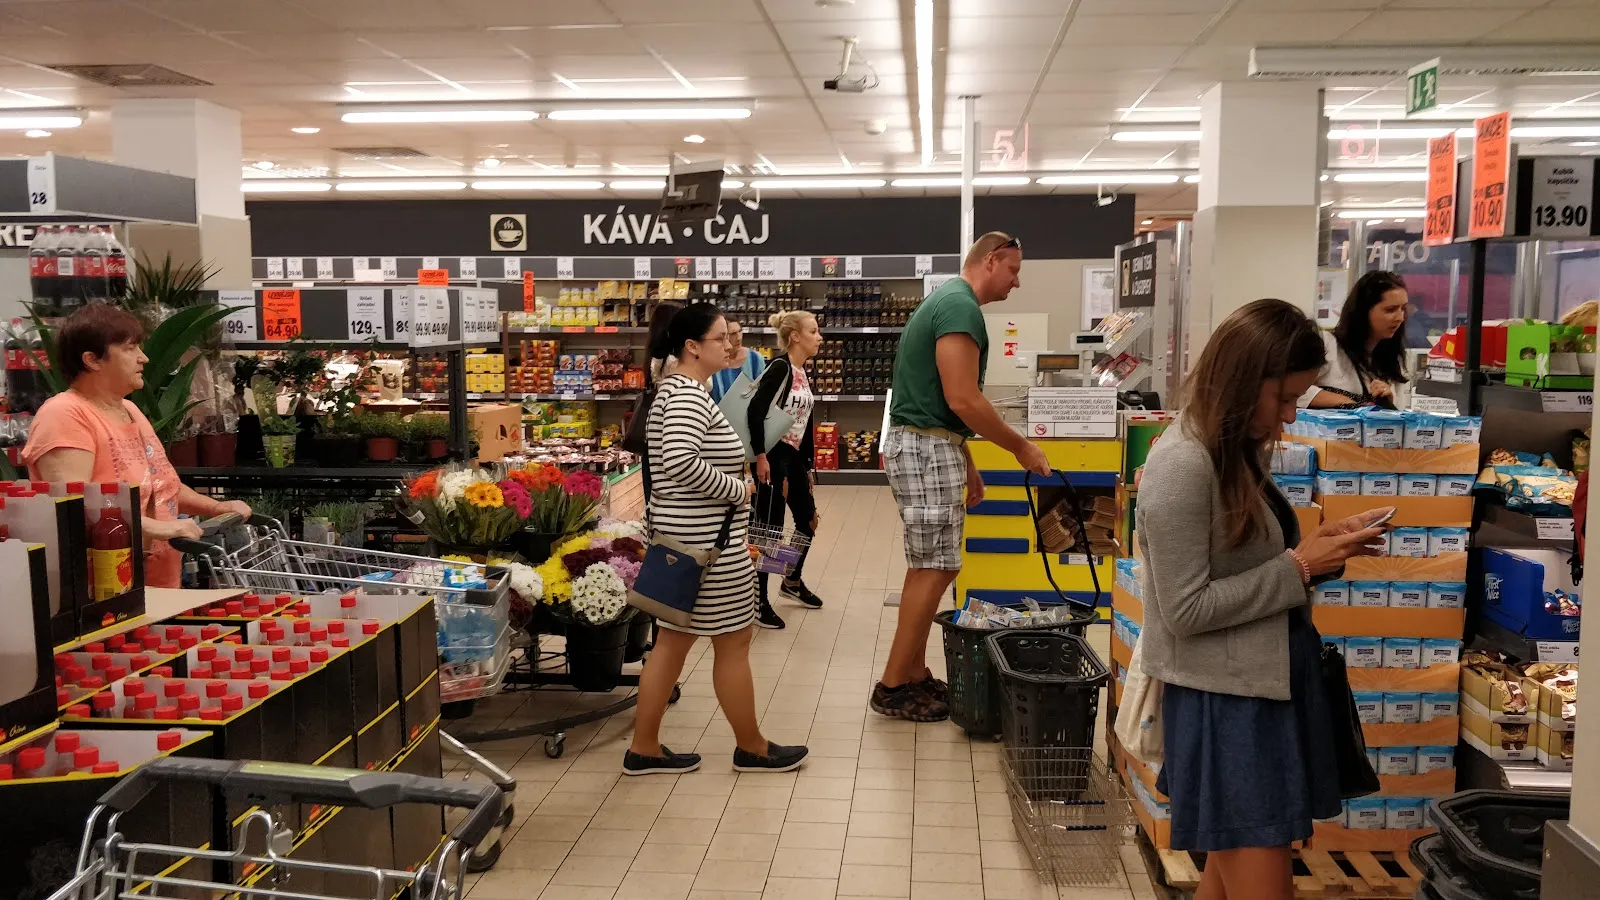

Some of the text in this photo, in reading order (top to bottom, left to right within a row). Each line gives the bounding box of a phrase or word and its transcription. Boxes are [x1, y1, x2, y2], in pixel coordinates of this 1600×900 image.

[32, 192, 48, 205] 28
[1474, 199, 1503, 228] 10.90
[1535, 205, 1588, 227] 13.90
[583, 205, 674, 245] KÁVA
[267, 325, 298, 336] 64.90
[351, 320, 382, 334] 129.-
